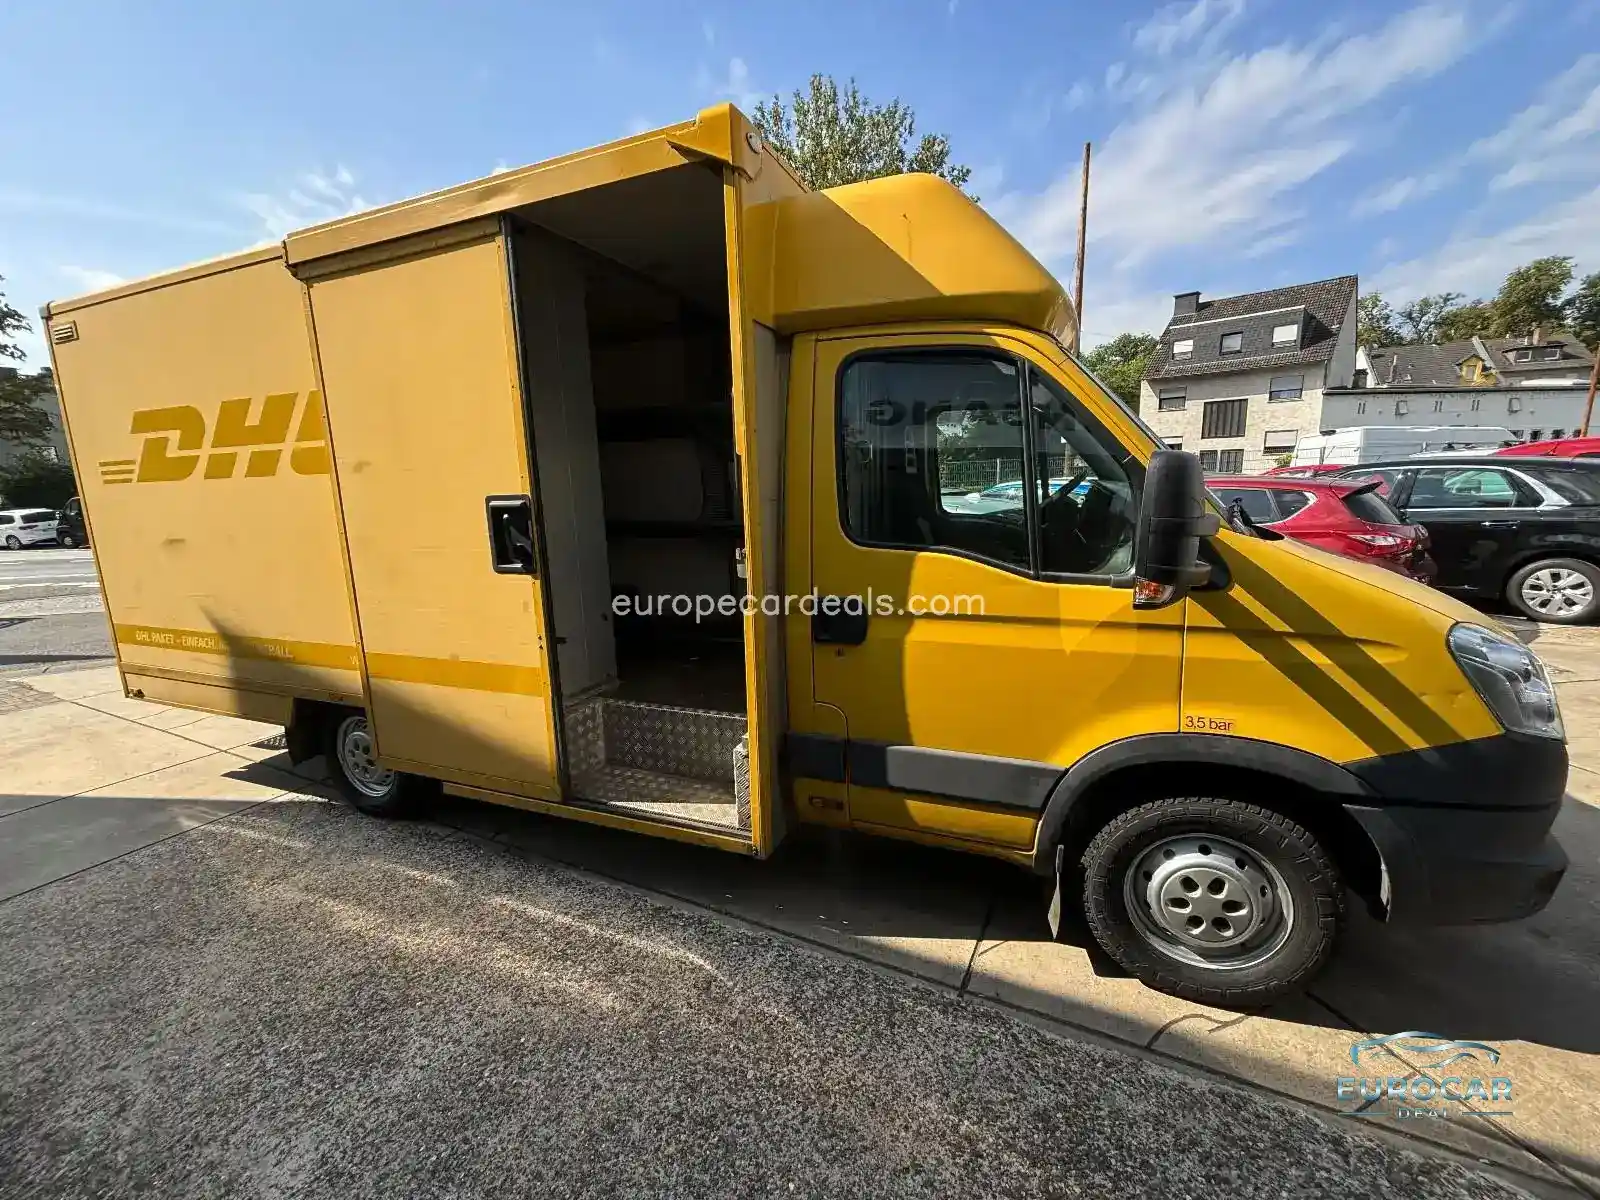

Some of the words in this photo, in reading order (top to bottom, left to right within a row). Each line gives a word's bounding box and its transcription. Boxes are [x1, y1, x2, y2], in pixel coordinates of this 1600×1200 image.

[135, 630, 149, 641] DHL
[151, 632, 174, 644] PAKET
[1209, 717, 1234, 731] bar
